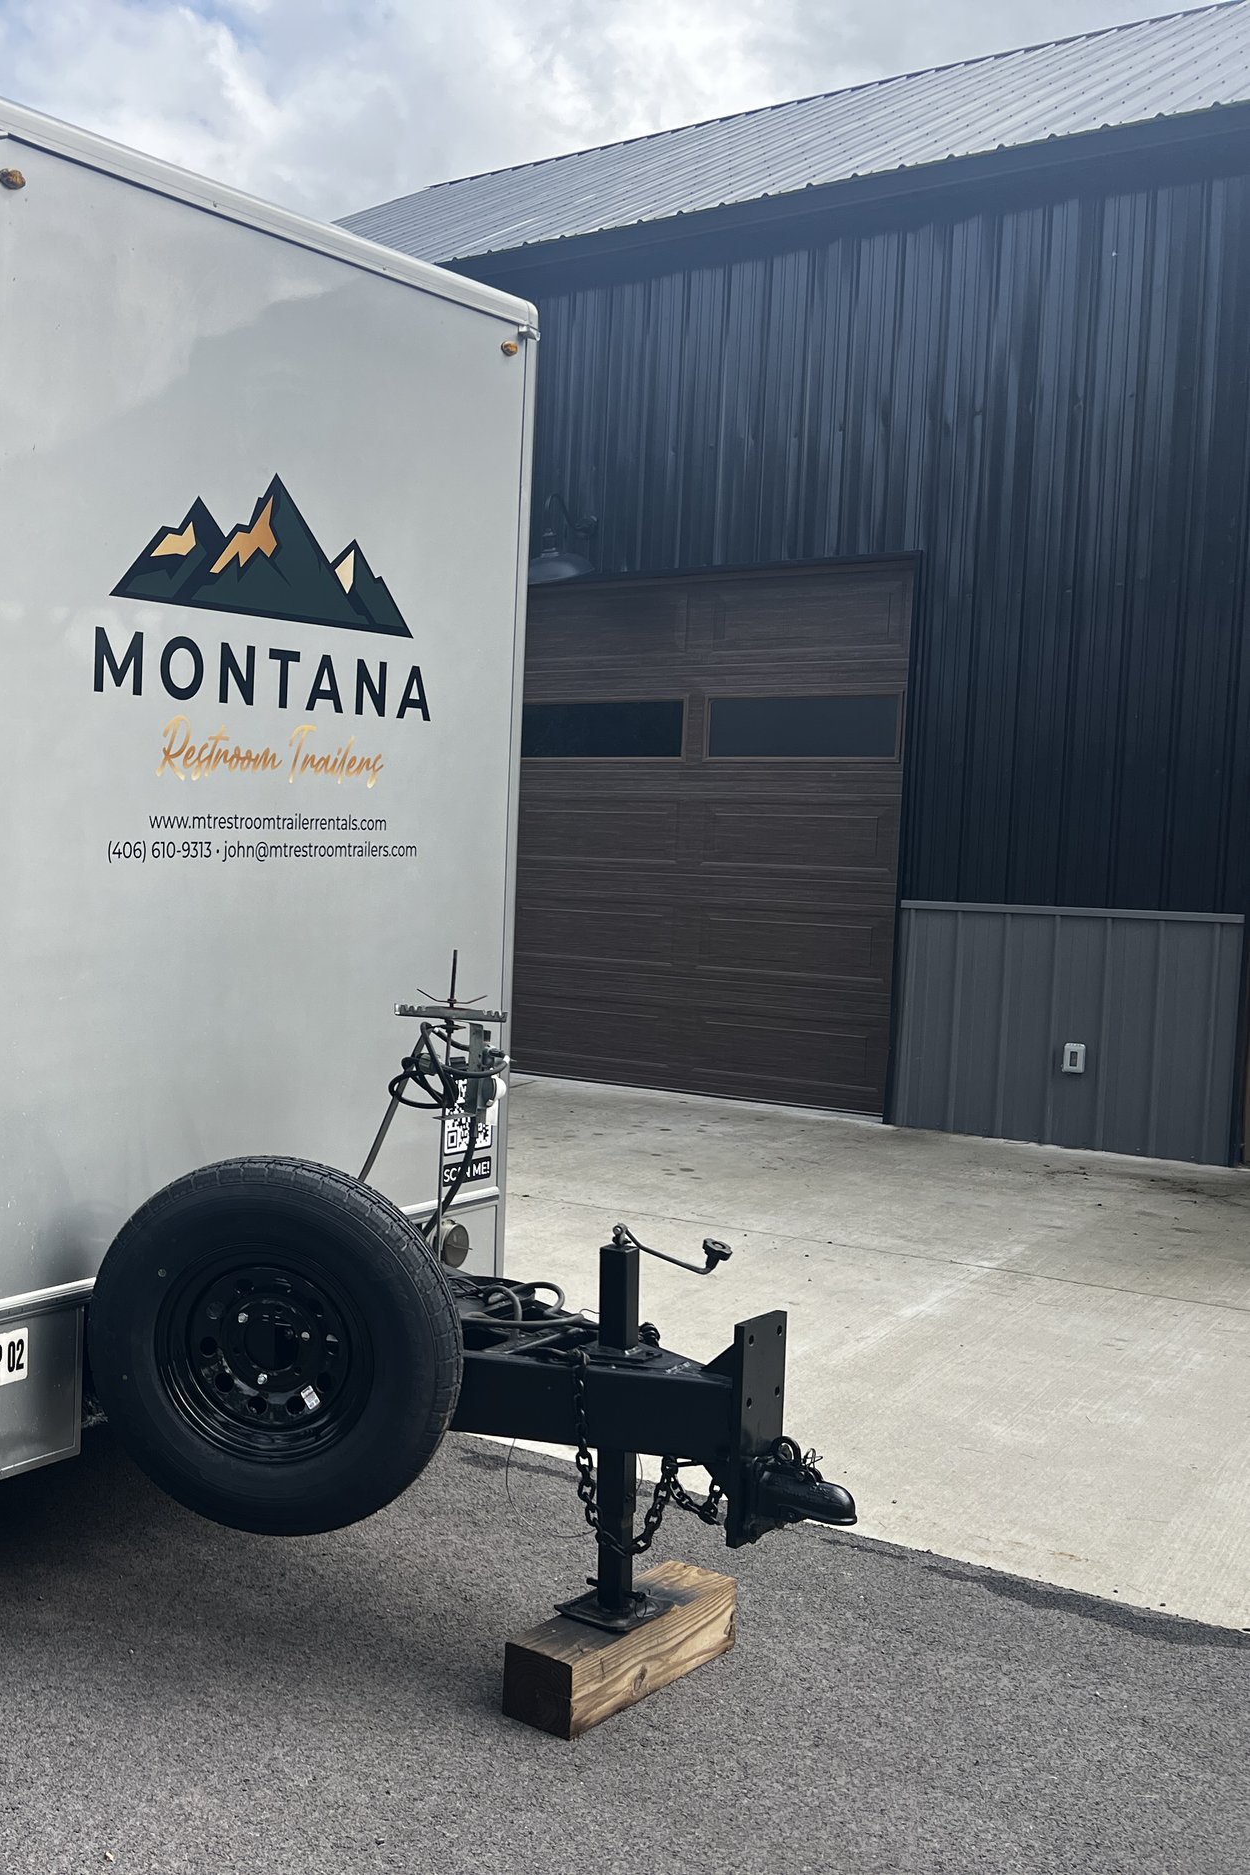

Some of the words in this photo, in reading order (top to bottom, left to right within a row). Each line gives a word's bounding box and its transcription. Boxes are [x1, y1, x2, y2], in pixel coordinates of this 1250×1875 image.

[94, 626, 431, 721] MONTANA
[155, 713, 283, 782] Restroom
[287, 724, 385, 789] Trailers
[148, 813, 388, 832] www.mtrestroomtrailerrentals.com
[106, 839, 147, 864] (406)
[150, 839, 212, 860] 610-9313
[221, 840, 418, 863] john@mtrestroomtrailers.com
[472, 1160, 491, 1177] ME!
[7, 1338, 25, 1373] 02
